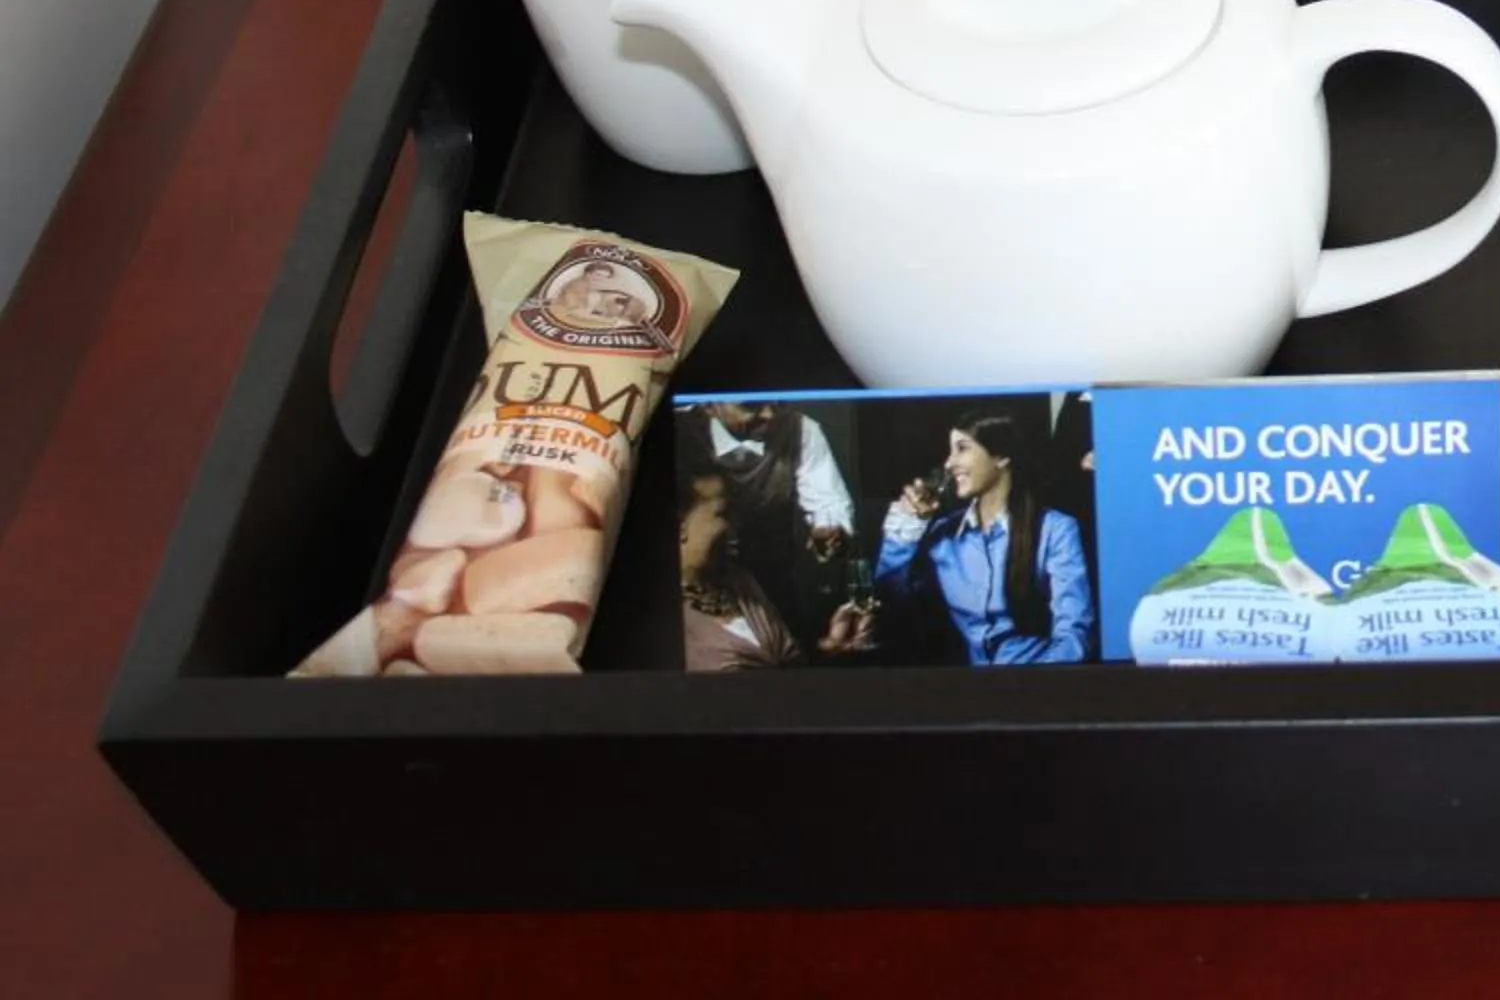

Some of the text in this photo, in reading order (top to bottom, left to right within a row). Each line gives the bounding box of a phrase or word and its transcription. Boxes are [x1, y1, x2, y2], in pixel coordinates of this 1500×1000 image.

[530, 315, 654, 347] THE ORIGINA
[509, 442, 578, 466] RUSK
[1153, 421, 1470, 464] AND CONQUER
[1153, 470, 1375, 506] YOUR DAY.
[1162, 605, 1312, 632] fresh milk
[1357, 610, 1423, 633] milk
[1152, 626, 1313, 657] Tastes like
[1357, 631, 1409, 655] like
